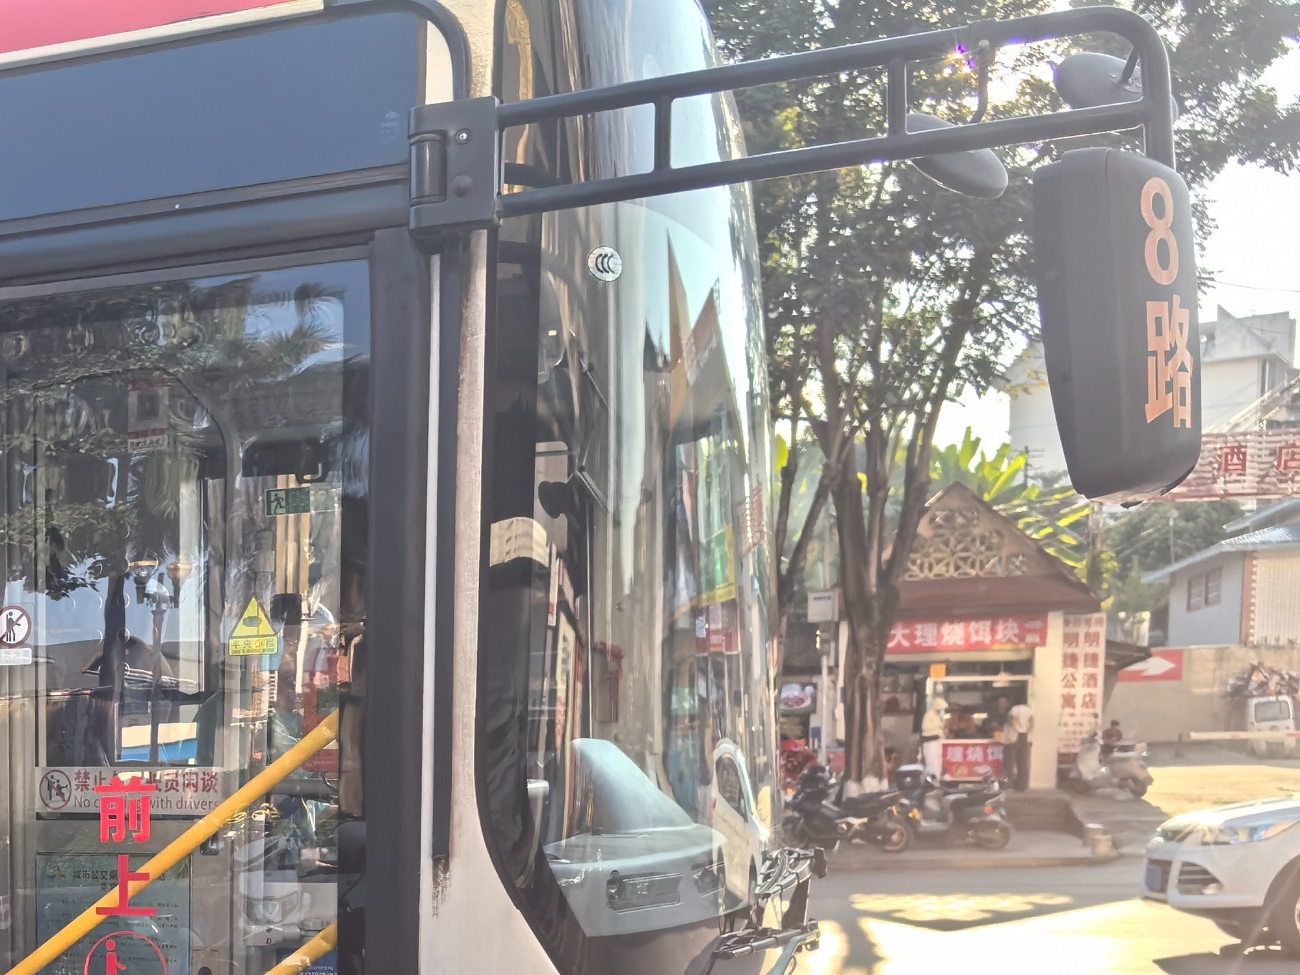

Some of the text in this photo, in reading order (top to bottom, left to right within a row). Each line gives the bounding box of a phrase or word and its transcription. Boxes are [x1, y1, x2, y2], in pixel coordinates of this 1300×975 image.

[1140, 176, 1194, 429] 8路
[74, 769, 219, 793] 禁止员闲谈
[74, 796, 91, 809] No
[94, 776, 158, 917] 前上
